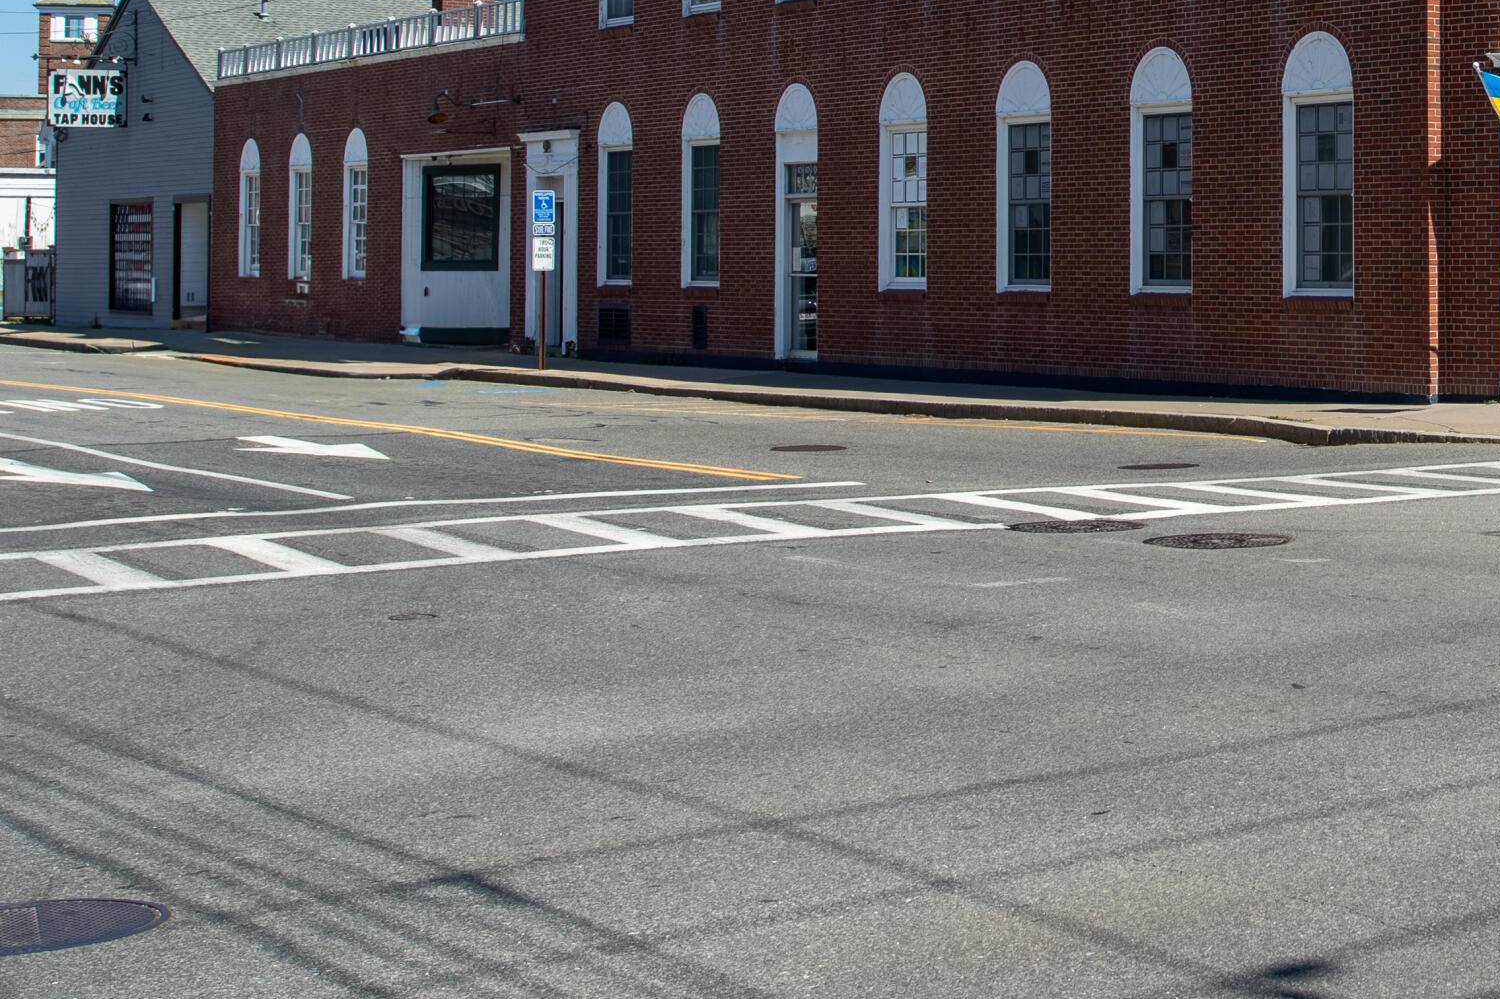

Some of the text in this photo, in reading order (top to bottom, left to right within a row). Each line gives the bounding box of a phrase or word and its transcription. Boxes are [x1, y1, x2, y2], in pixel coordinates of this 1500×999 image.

[54, 74, 124, 95] FNN'S
[54, 113, 124, 126] TAP HOUSE
